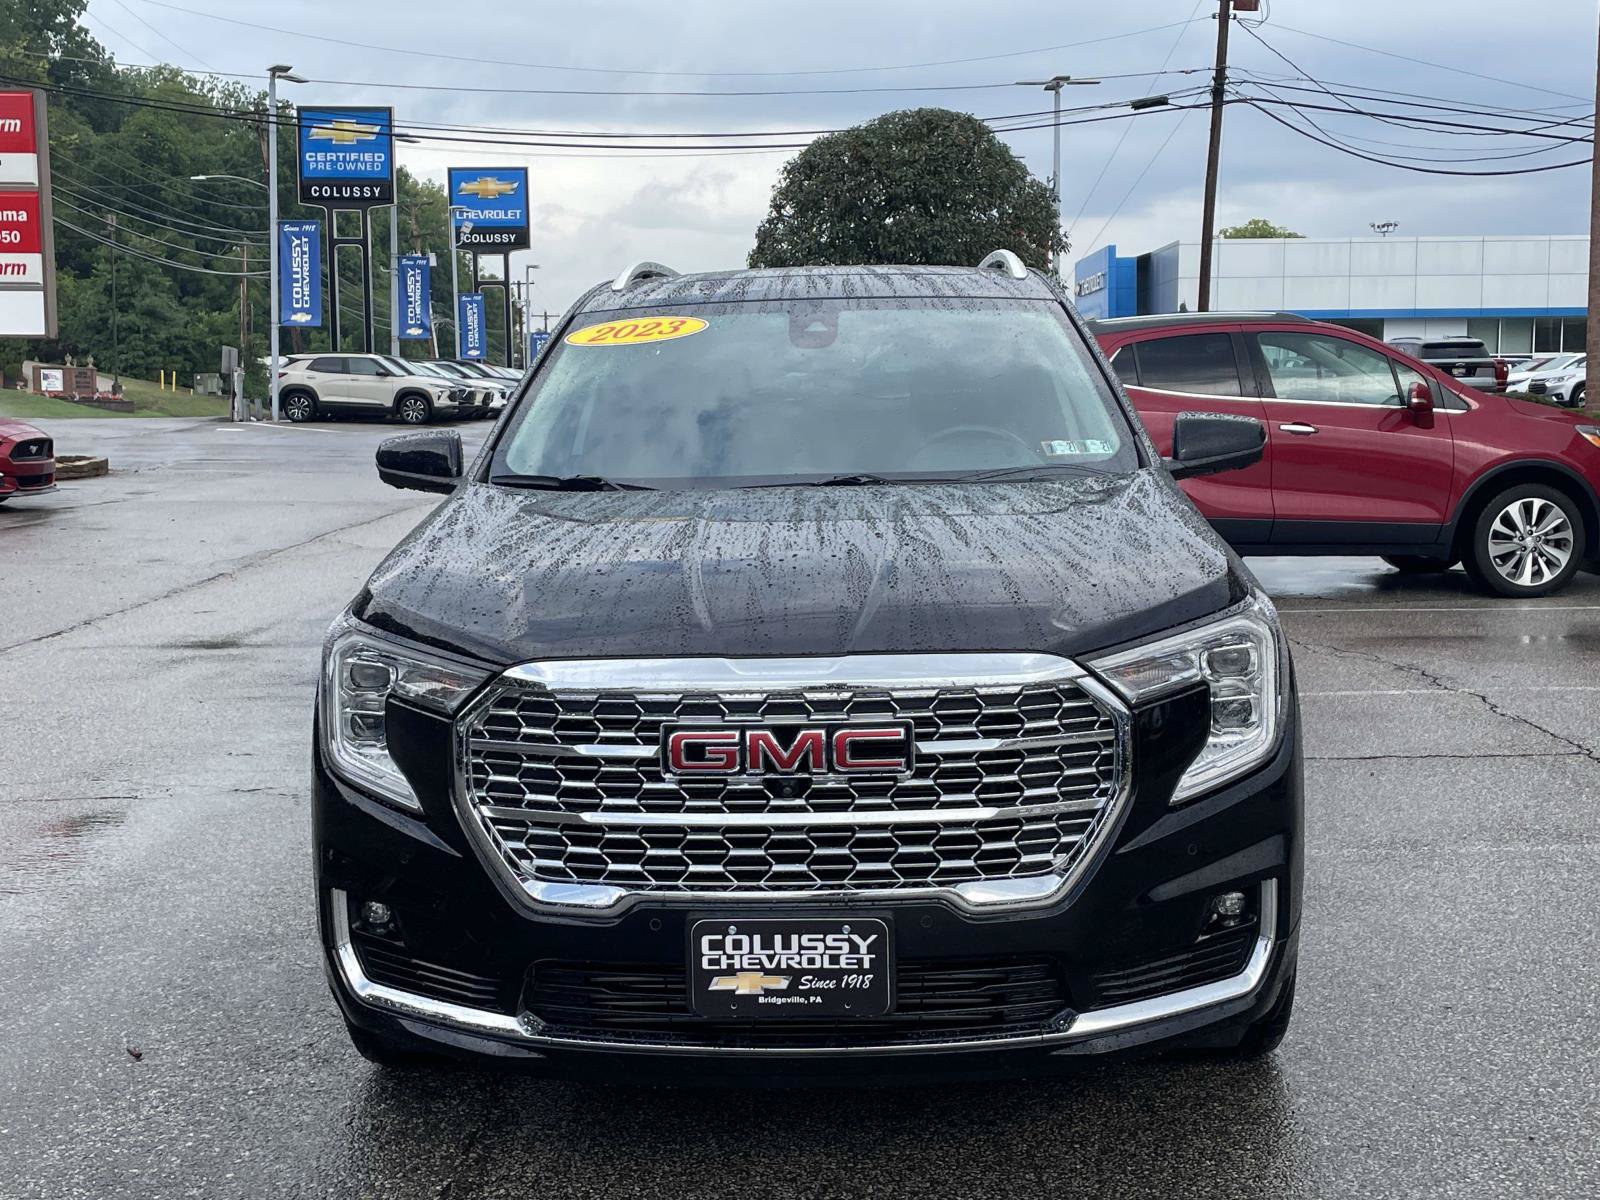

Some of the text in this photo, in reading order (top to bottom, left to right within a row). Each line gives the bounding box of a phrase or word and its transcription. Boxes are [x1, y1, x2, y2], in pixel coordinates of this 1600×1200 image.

[305, 152, 385, 161] CERTIFIED
[309, 162, 382, 171] PRE-OWNED
[311, 186, 380, 197] COLUSSY
[0, 210, 28, 221] ma
[0, 230, 21, 243] 50
[464, 233, 516, 243] COLUSSY
[291, 235, 302, 308] COLUSSY
[302, 235, 310, 308] CHEVROLET
[407, 268, 415, 324] COLUSSY
[587, 320, 687, 342] 2023
[669, 727, 906, 772] GMC
[701, 934, 878, 955] COLUSSY
[701, 954, 876, 969] CHEVROLET
[798, 974, 874, 990] Since 1918
[758, 995, 822, 1005] Bridgeville, PA
